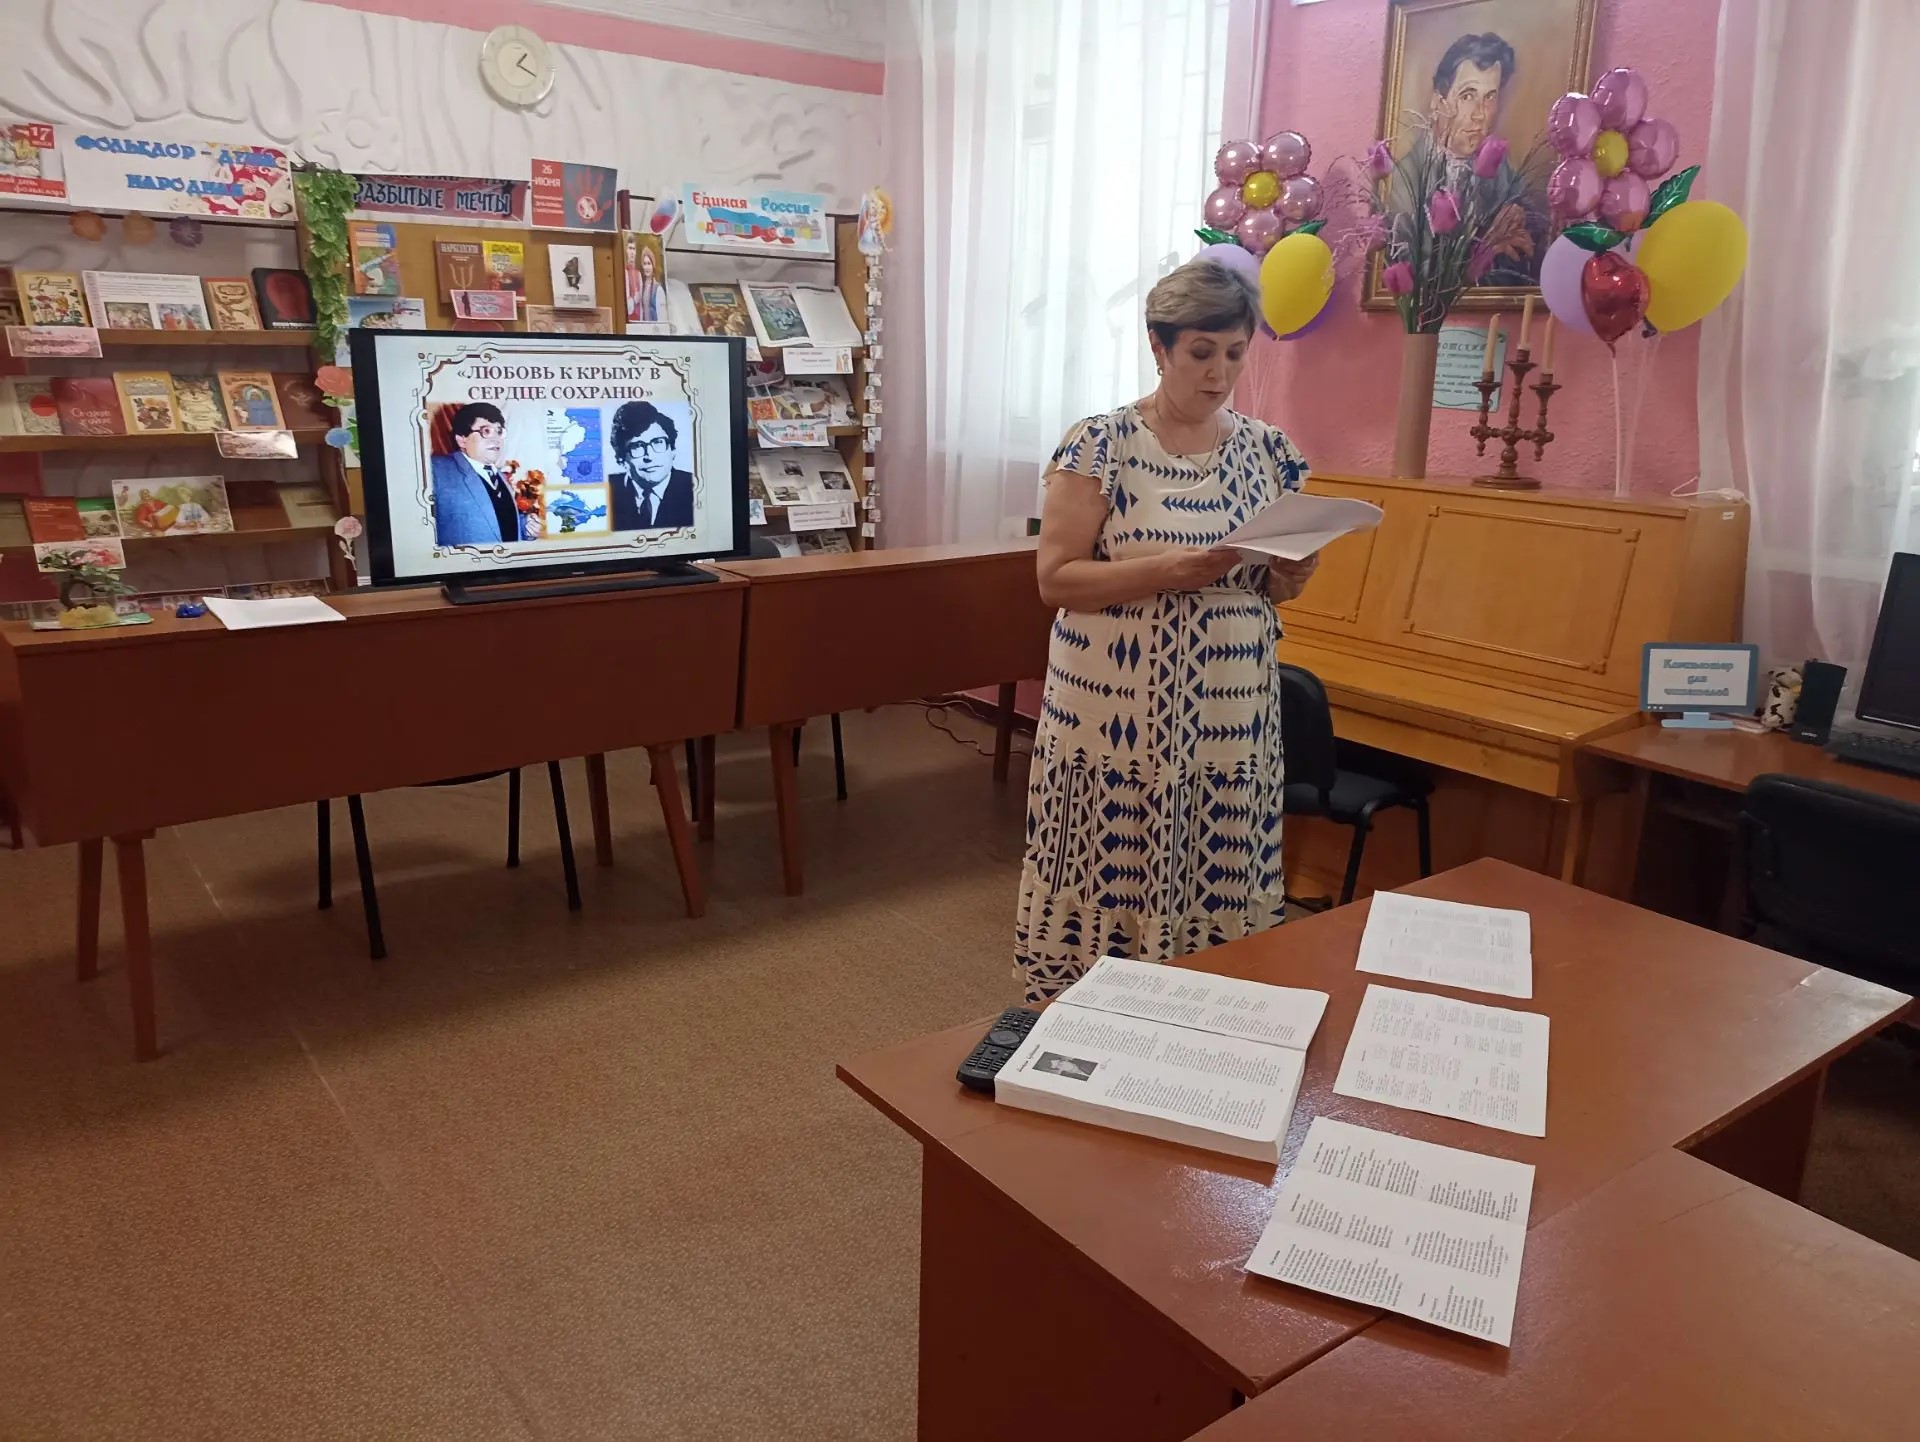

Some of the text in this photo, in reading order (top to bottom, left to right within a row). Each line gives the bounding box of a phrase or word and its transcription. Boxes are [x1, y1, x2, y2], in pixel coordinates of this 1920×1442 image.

[30, 126, 52, 141] 17
[354, 181, 444, 210] РАЗБИТЫЕ
[456, 190, 511, 214] МЕЧТЫ
[760, 197, 811, 215] Россия
[457, 365, 661, 380] «ЛЮБОВЬ К КРЫМУ В
[467, 386, 654, 401] СЕРДЦЕ СОХРАНЮ»
